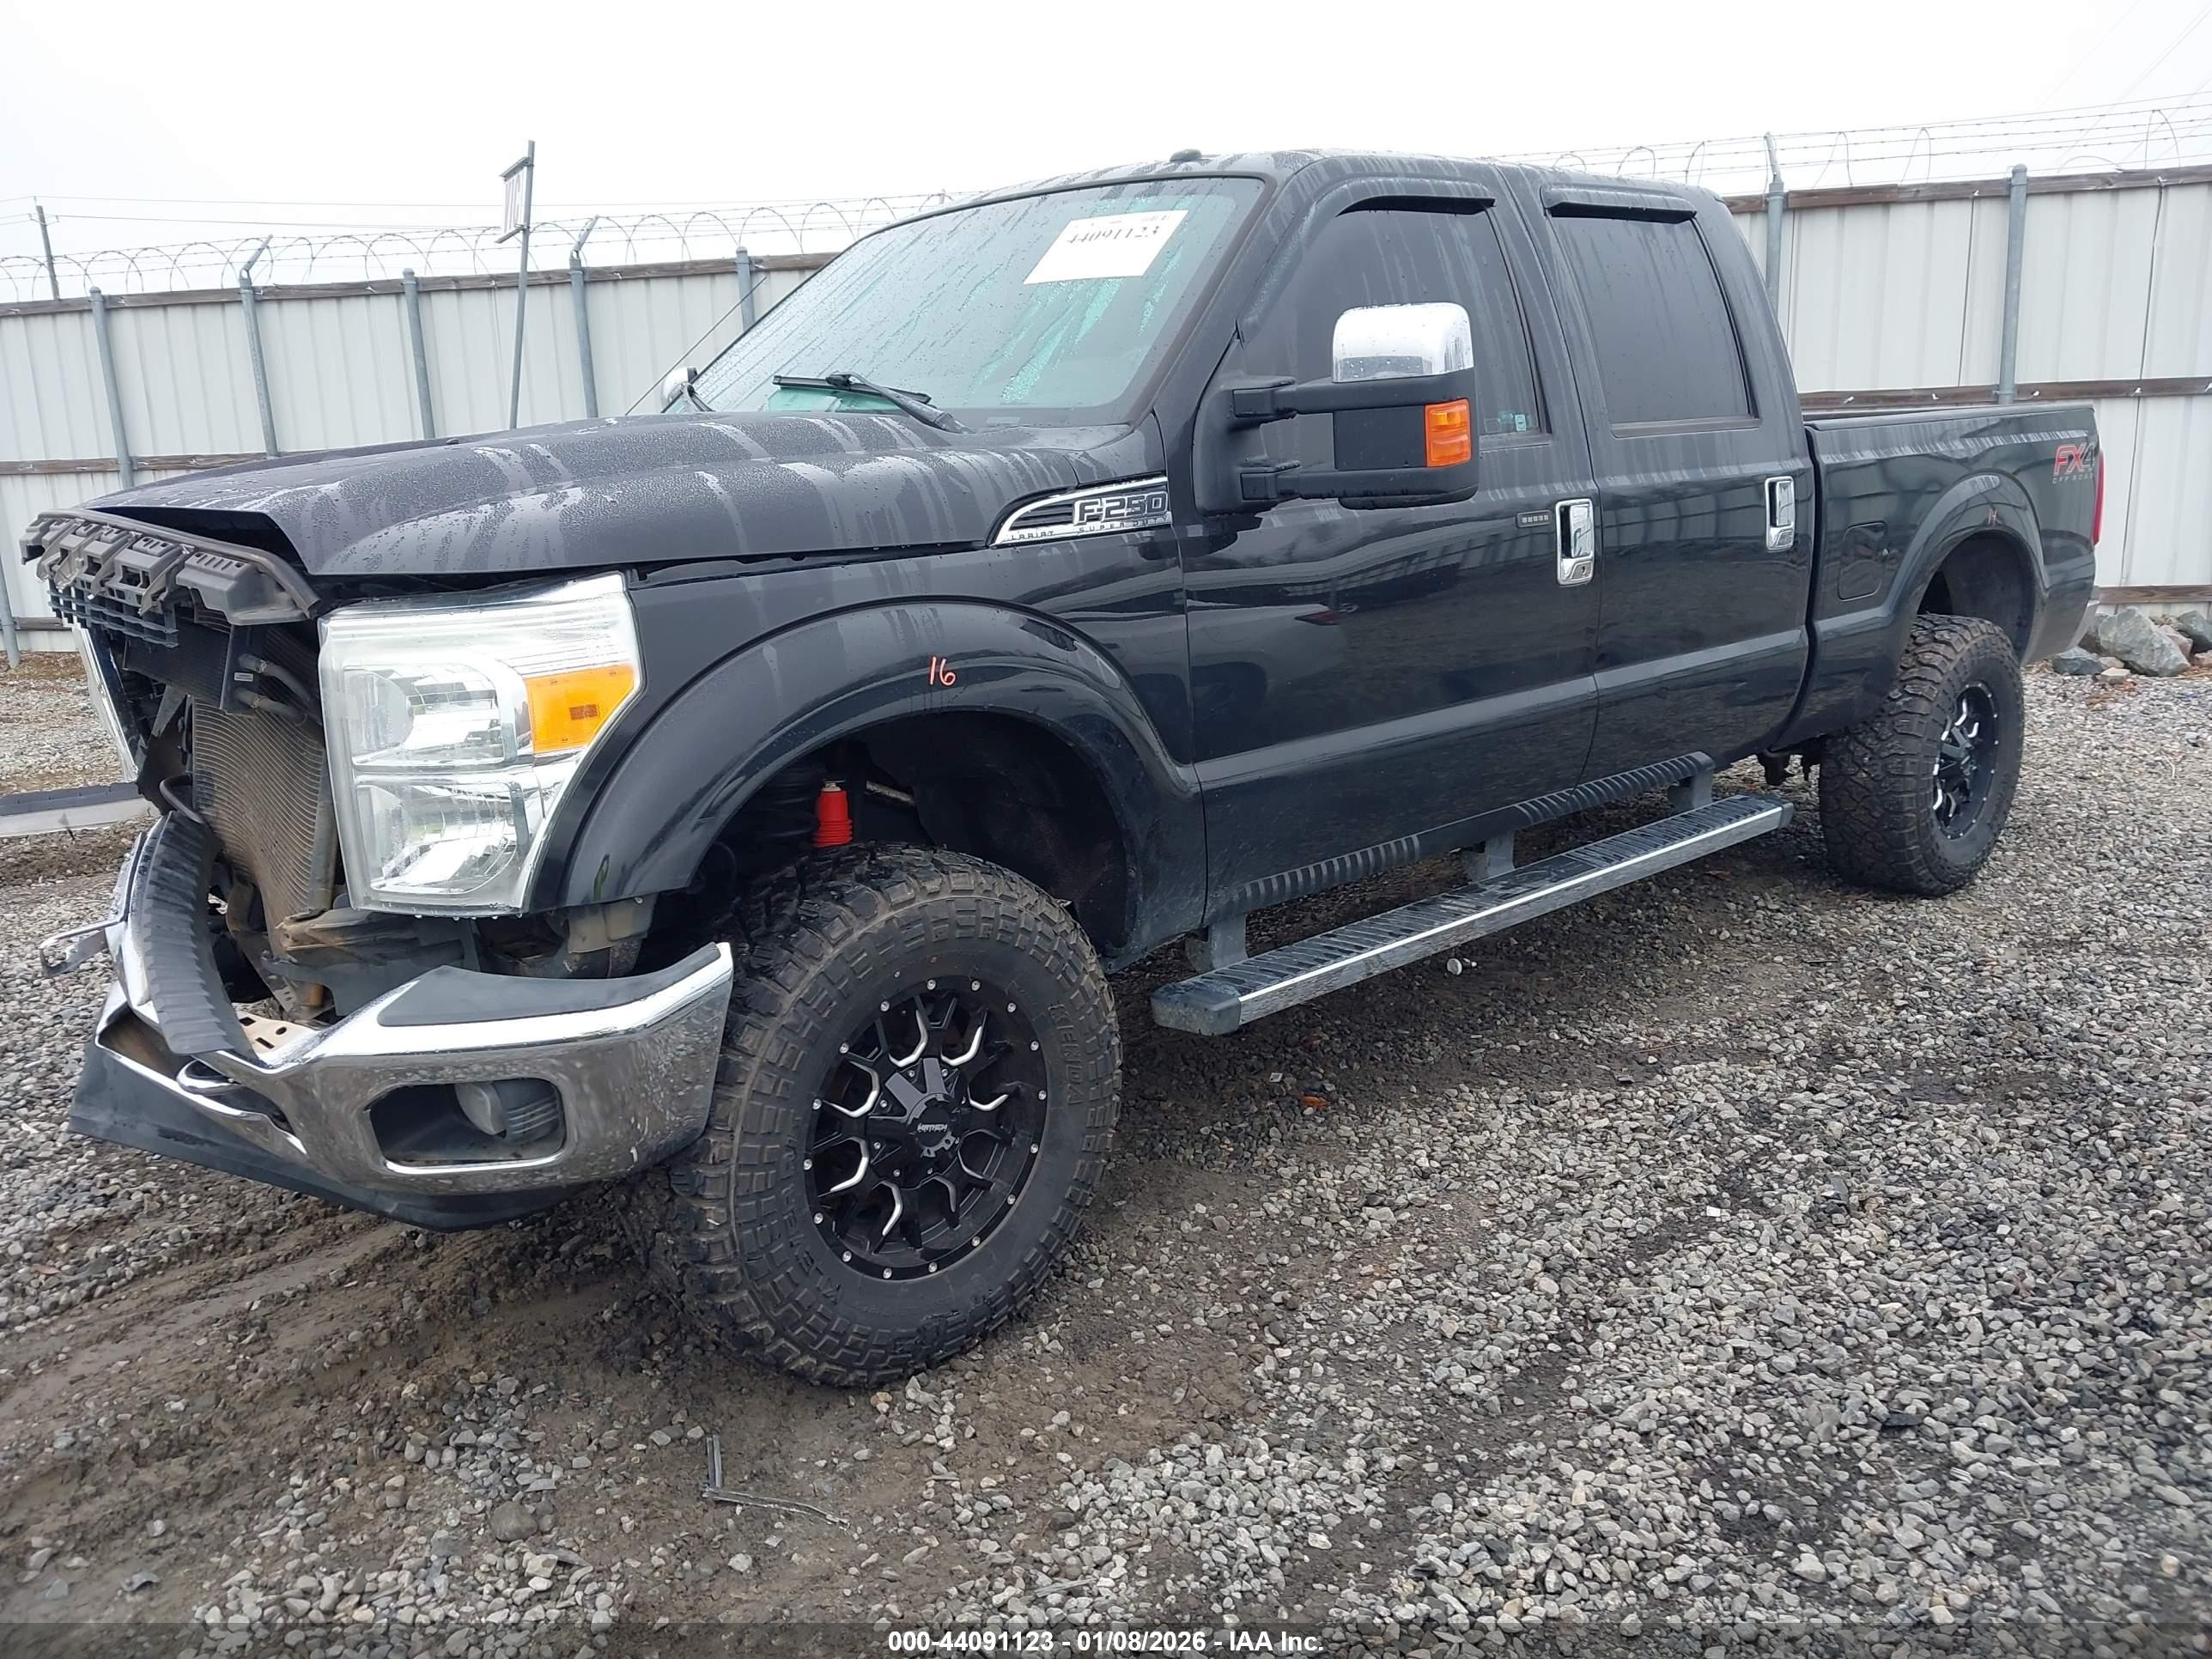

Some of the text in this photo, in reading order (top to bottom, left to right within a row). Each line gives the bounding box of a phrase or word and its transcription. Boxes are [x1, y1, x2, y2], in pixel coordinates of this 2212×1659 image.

[2053, 442, 2095, 477] FX4
[1073, 491, 1169, 526] F-250
[1012, 531, 1054, 541] LARIAT
[1079, 522, 1125, 533] SUPER
[929, 655, 957, 687] 16
